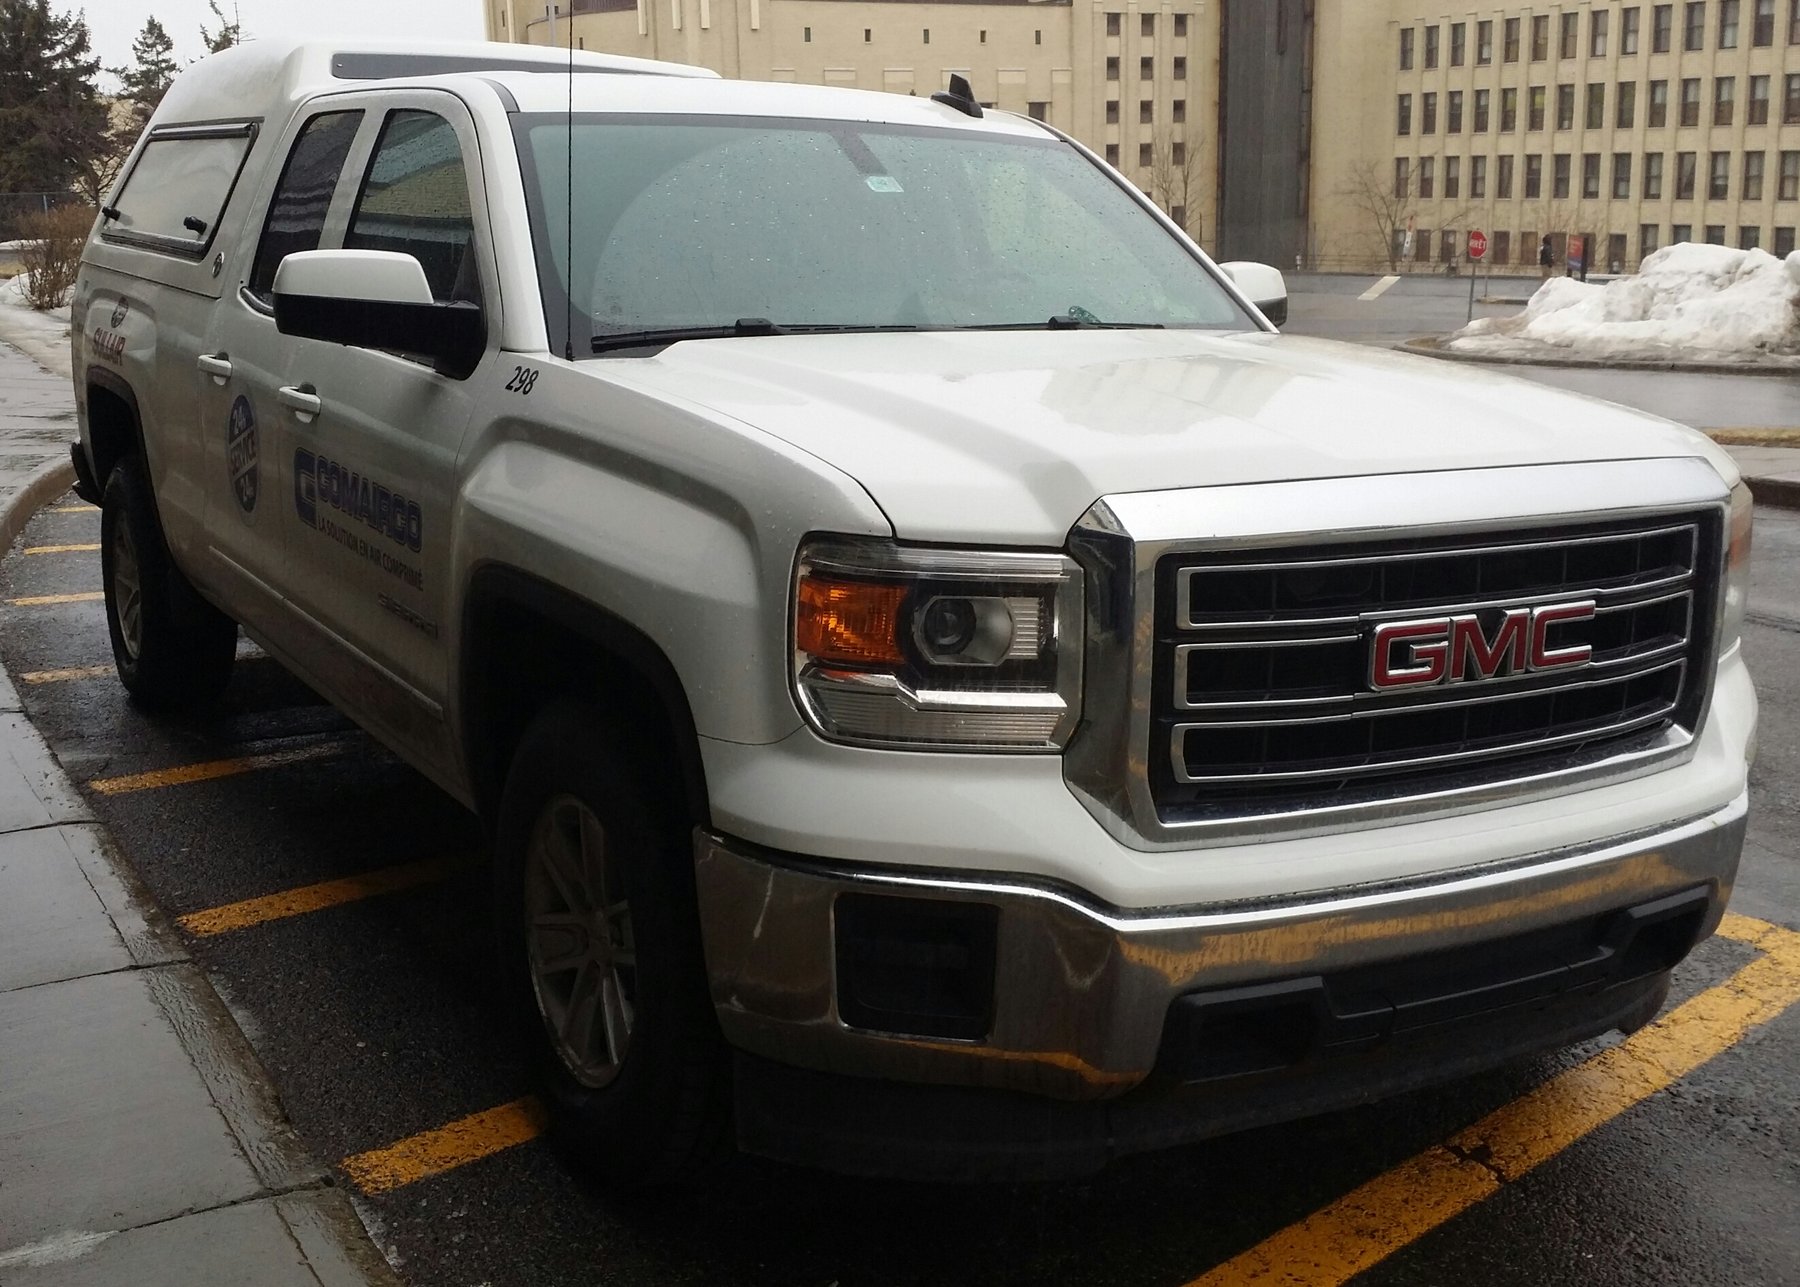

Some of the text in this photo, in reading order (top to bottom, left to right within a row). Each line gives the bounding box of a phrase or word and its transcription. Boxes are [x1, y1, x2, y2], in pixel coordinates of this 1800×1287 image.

[505, 365, 539, 395] 298
[316, 455, 423, 553] COMAIRCO
[1368, 600, 1596, 692] GMC
